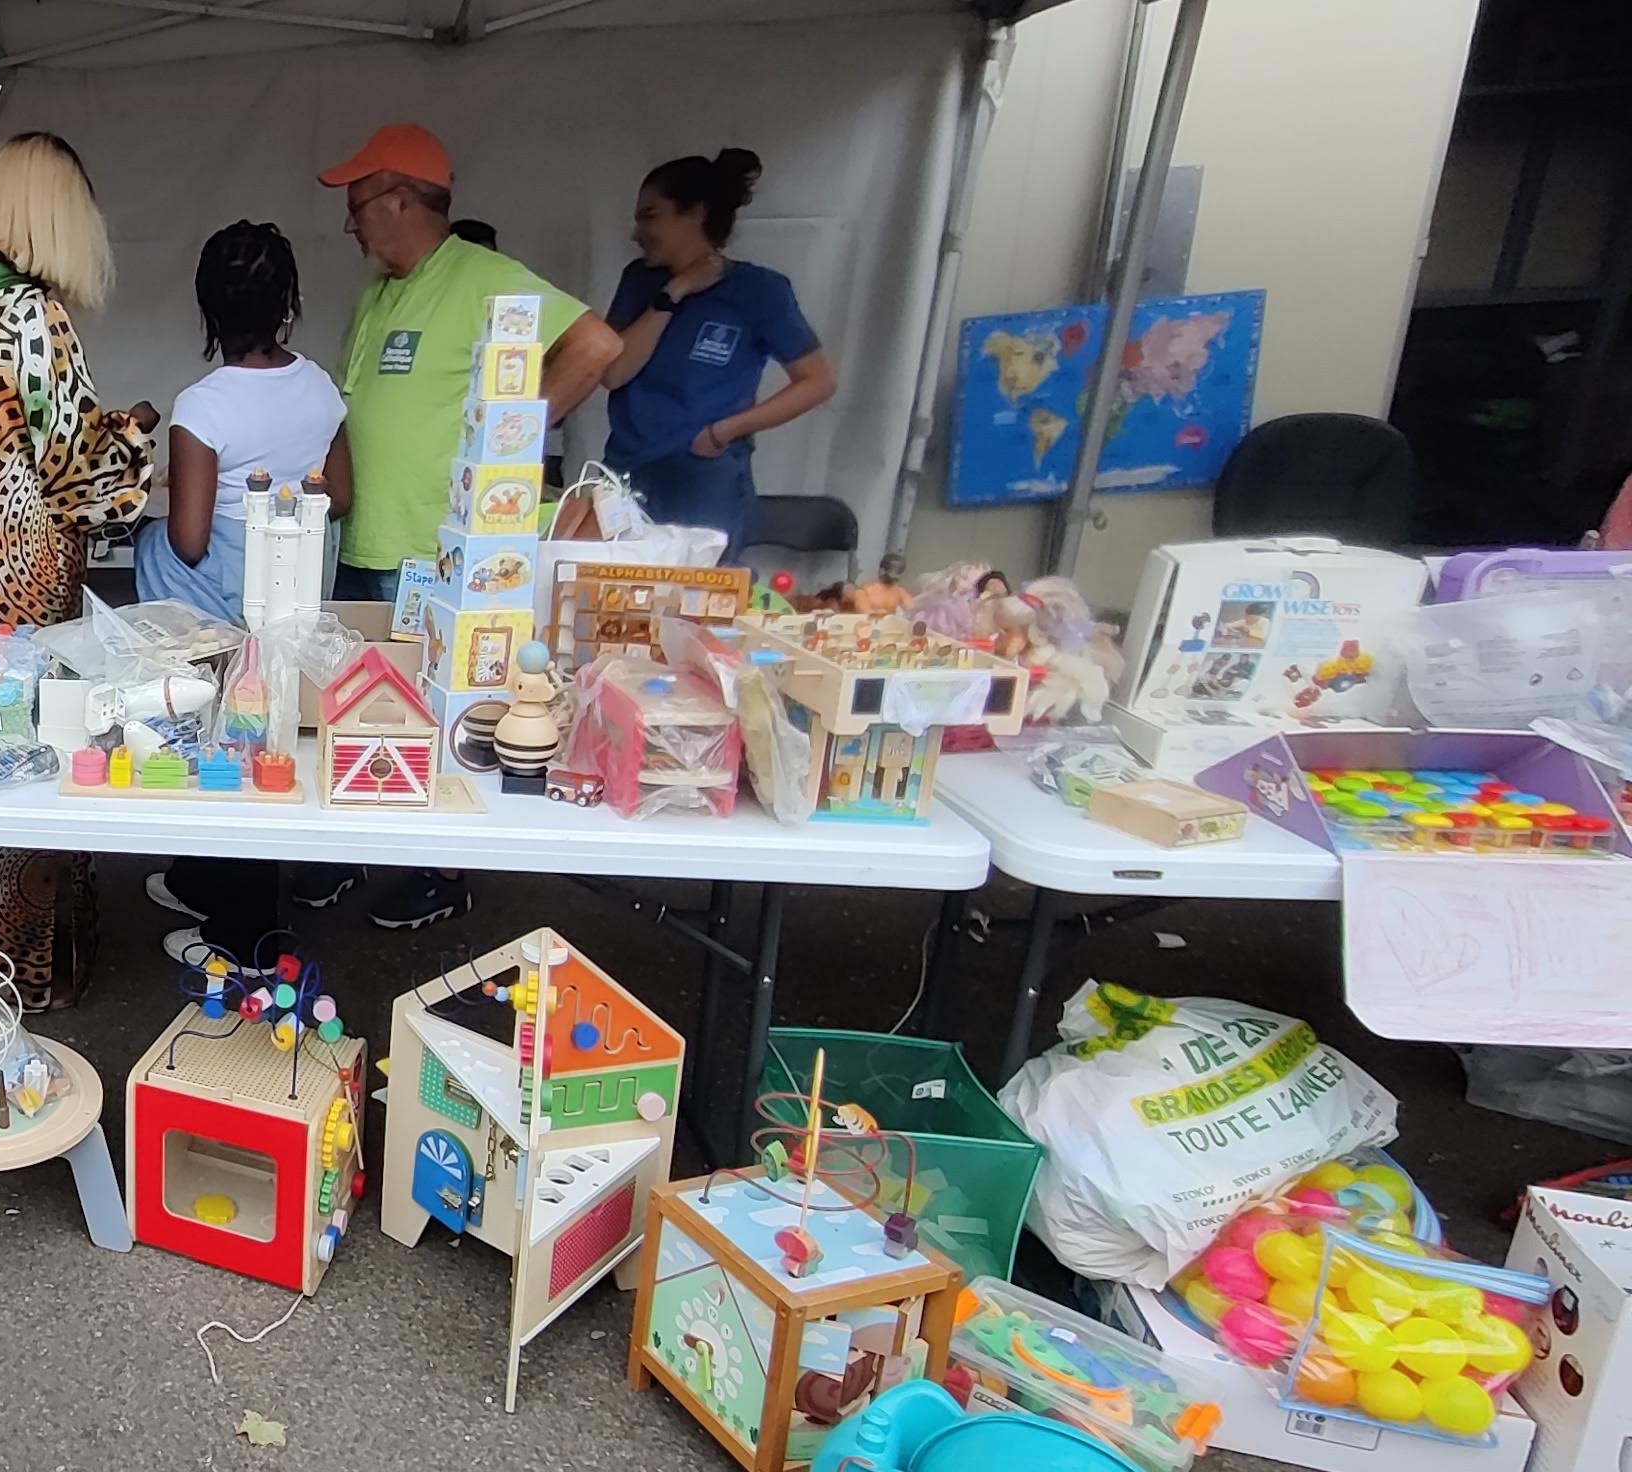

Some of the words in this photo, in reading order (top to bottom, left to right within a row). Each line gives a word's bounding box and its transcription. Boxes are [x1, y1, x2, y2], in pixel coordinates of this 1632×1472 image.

[599, 566, 673, 580] ALPHABET
[695, 570, 732, 585] BOIS
[1222, 582, 1295, 599] GROW
[1283, 601, 1330, 615] WISE
[1331, 604, 1361, 616] TOYS
[1179, 1033, 1239, 1075] DE
[1140, 1063, 1267, 1122] GRANDES
[1167, 1104, 1271, 1154] TOUTE
